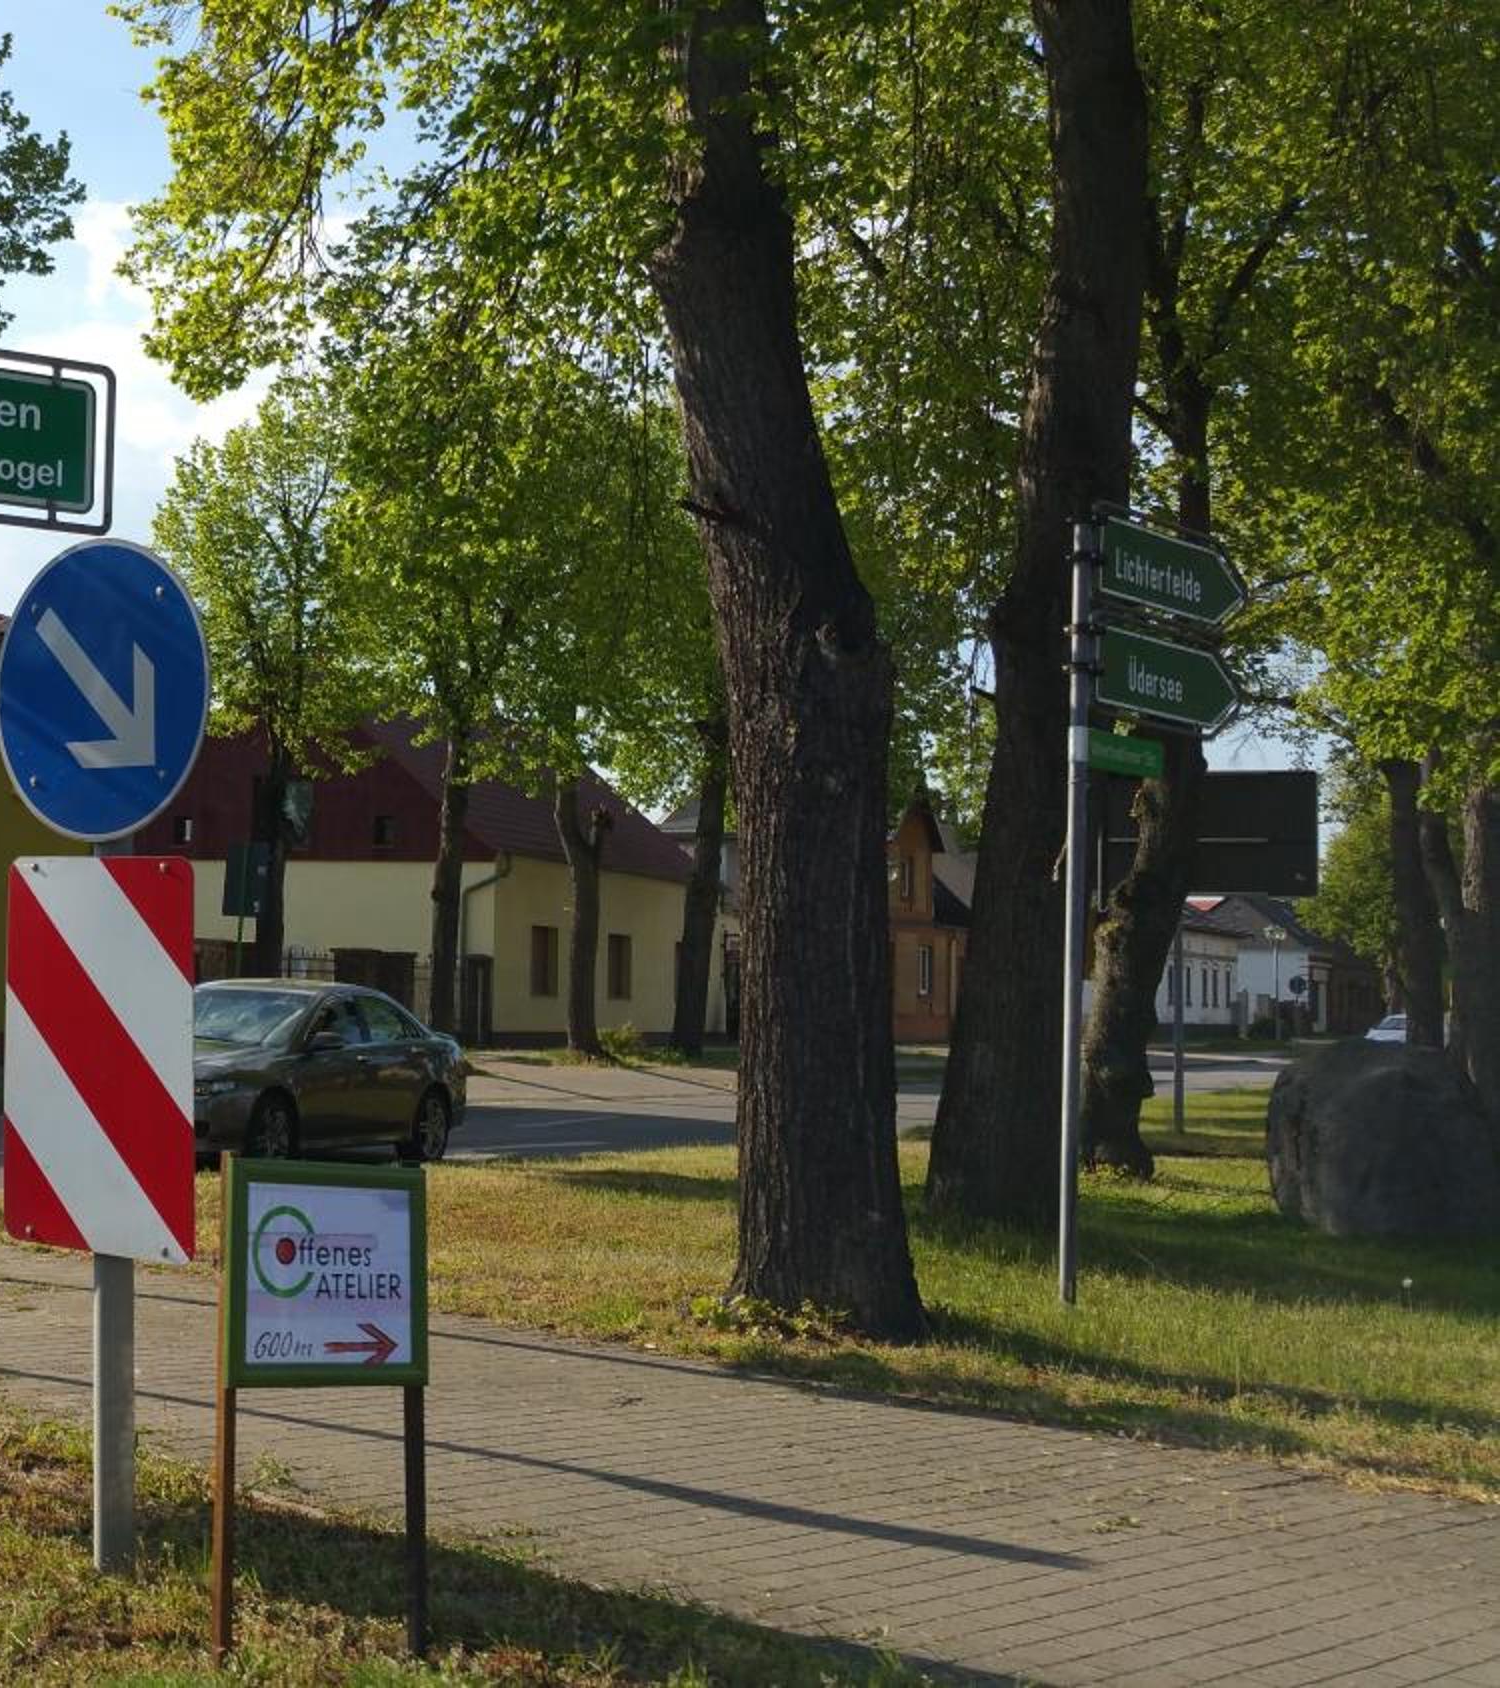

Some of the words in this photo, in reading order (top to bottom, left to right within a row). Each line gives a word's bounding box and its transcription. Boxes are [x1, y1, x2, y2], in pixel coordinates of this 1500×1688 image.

[1115, 547, 1201, 602] Lichterfelde
[1128, 655, 1184, 703] Üdersee
[313, 1273, 402, 1300] ATELIER
